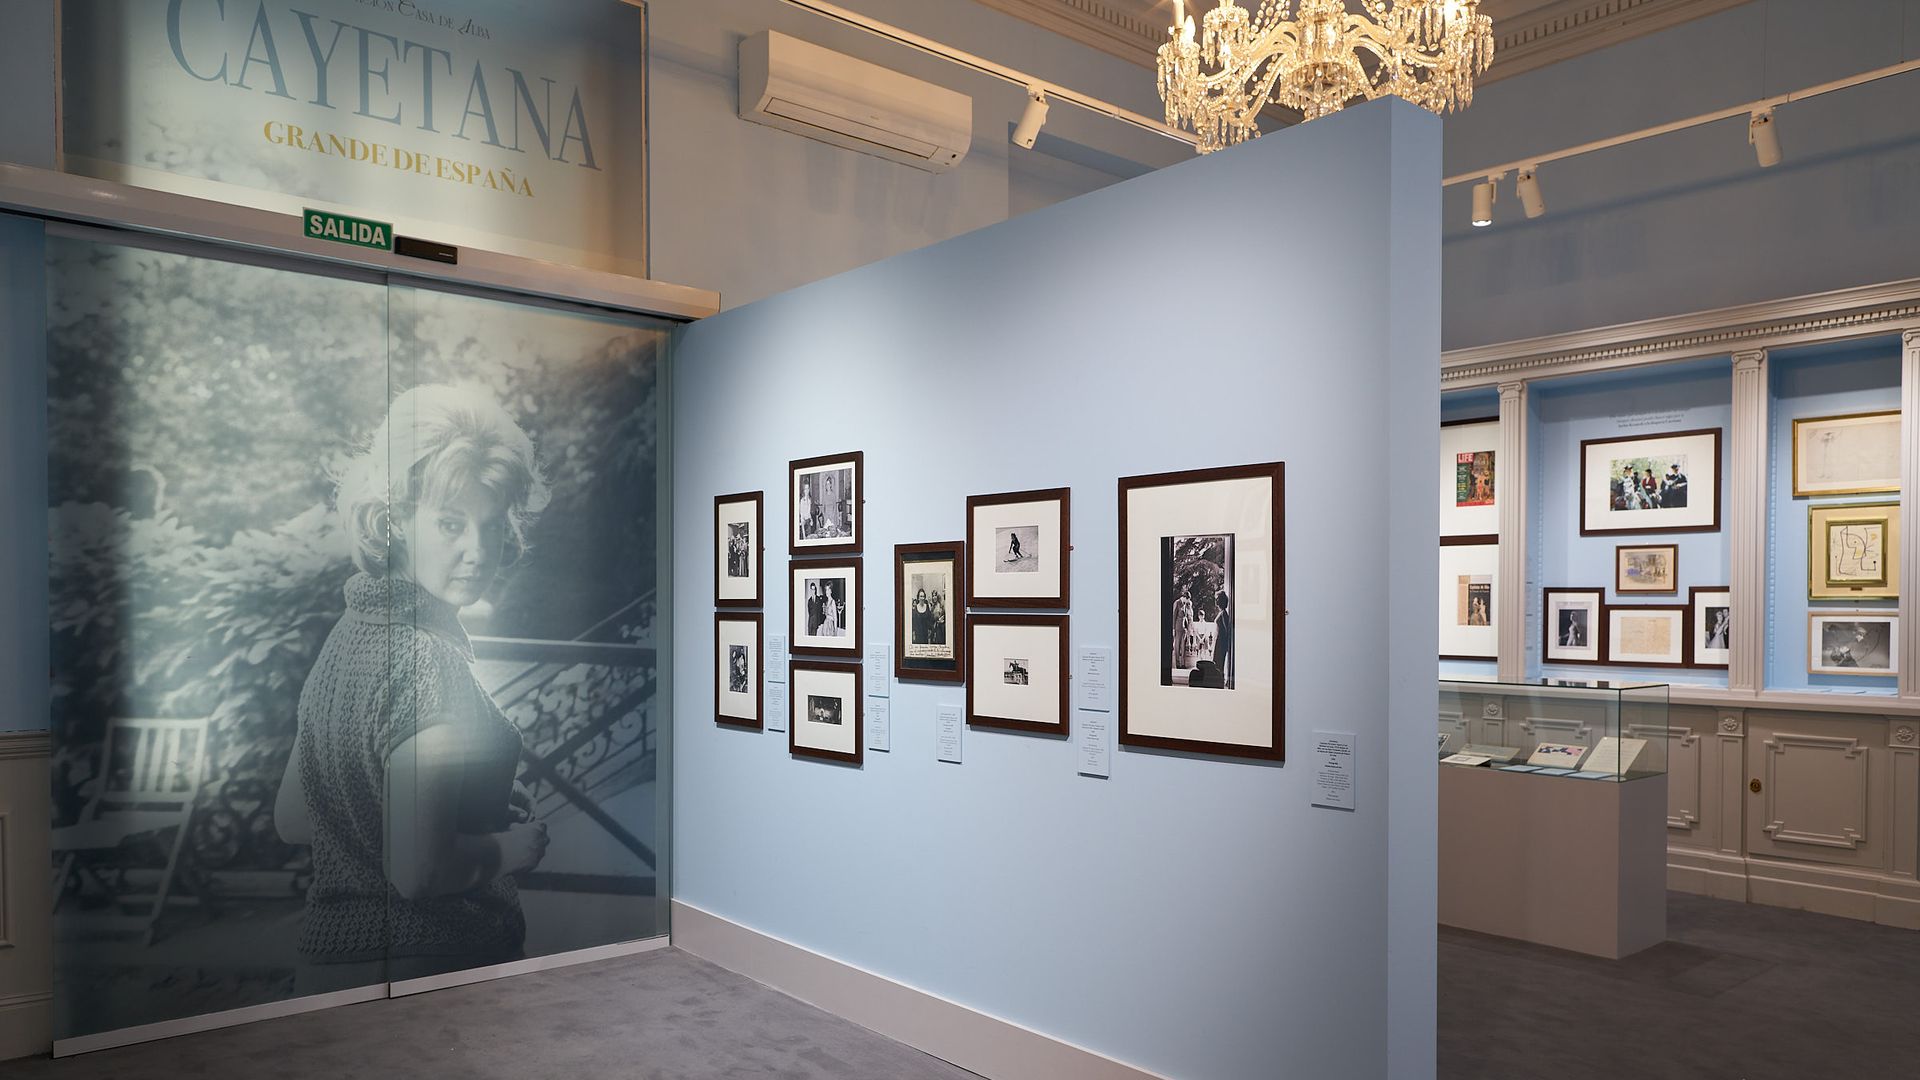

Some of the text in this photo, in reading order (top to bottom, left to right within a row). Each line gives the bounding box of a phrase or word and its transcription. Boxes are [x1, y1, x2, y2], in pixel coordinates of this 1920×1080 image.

[439, 15, 455, 30] DE
[457, 18, 491, 40] ALBA
[165, 0, 603, 172] CAYETANA
[263, 120, 535, 198] GRANDE DE ESPAÑA
[309, 214, 387, 247] SALIDA
[1458, 453, 1474, 463] LIFE
